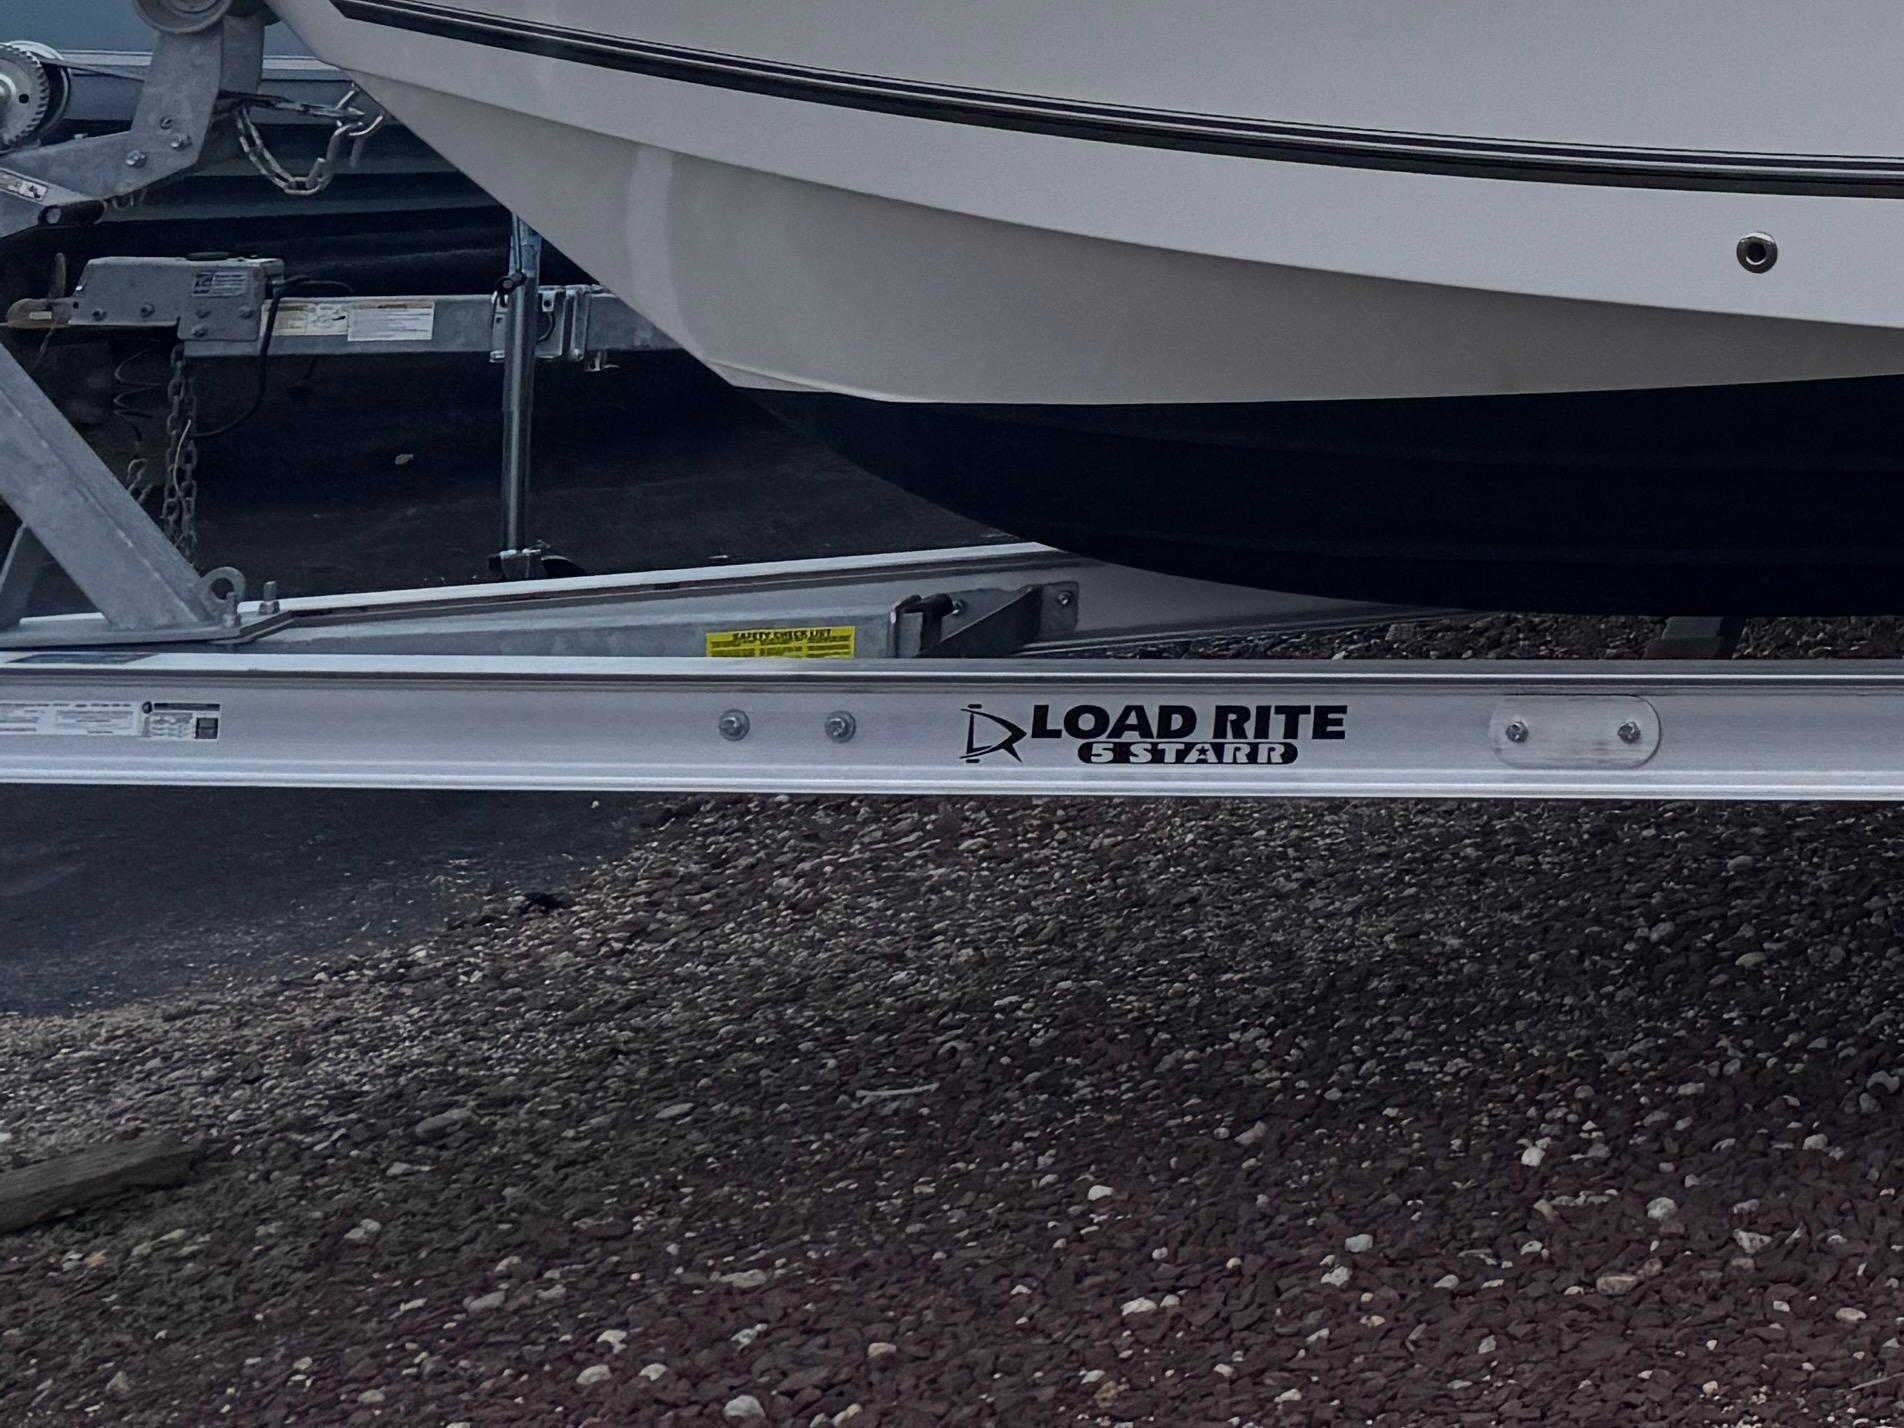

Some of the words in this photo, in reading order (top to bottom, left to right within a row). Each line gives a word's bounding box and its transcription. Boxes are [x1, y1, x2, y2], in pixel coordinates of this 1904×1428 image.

[1031, 704, 1197, 739] LOAD
[1212, 704, 1348, 740] RITE
[1090, 743, 1114, 764] 5
[1129, 743, 1286, 764] STARR
